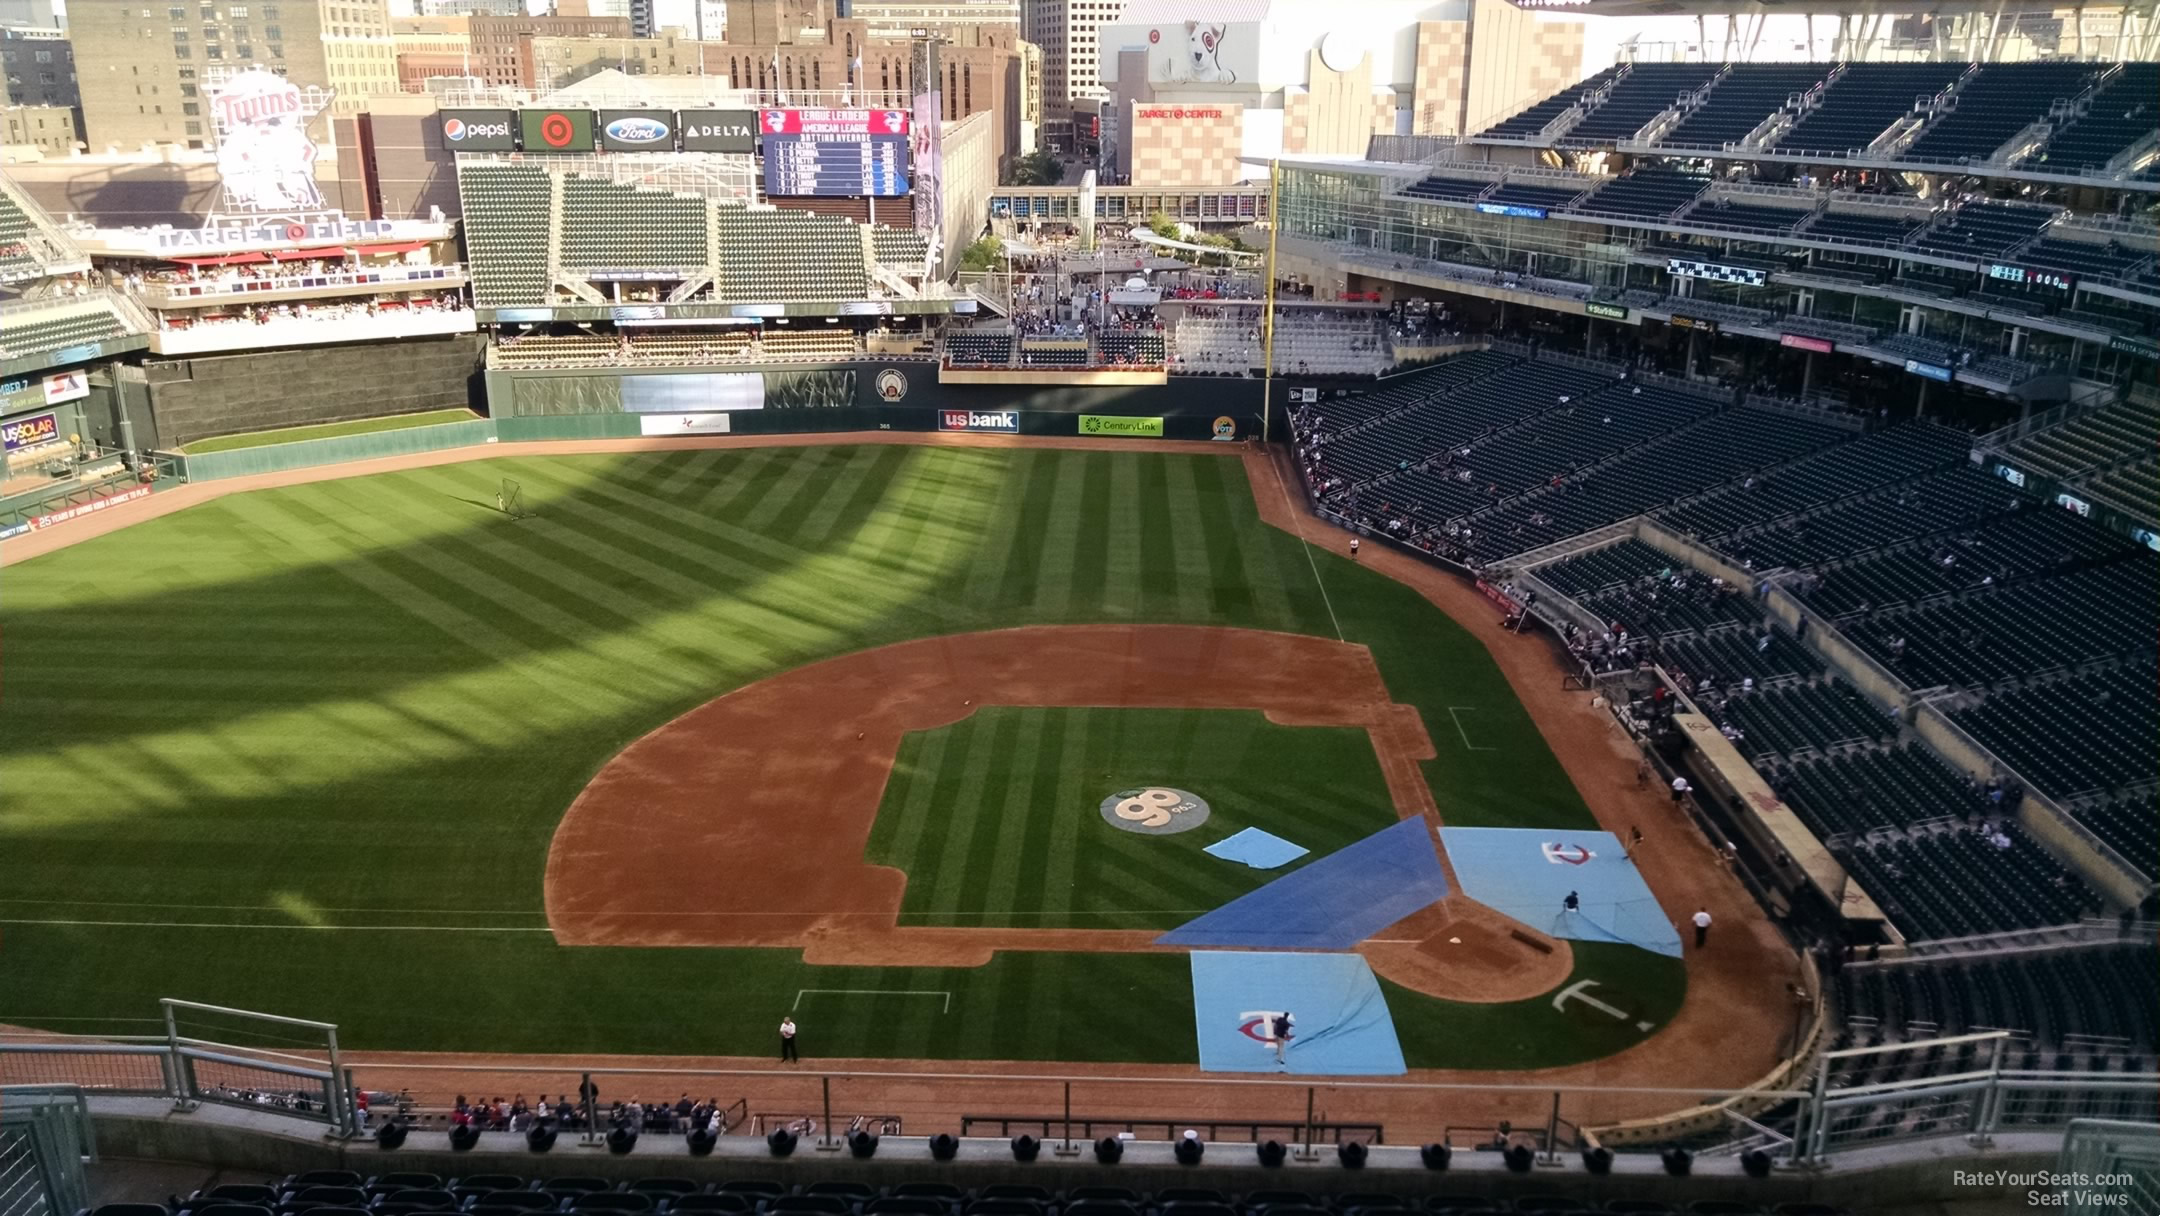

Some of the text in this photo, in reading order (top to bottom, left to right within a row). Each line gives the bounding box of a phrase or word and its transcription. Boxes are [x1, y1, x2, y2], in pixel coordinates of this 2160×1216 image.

[216, 91, 299, 127] Twins
[799, 110, 869, 120] LEAGUE LEADERS
[1138, 109, 1222, 118] TARGET CENTER
[467, 122, 510, 138] pepsi
[618, 122, 656, 139] Ford
[702, 125, 750, 137] DELTA
[801, 123, 869, 133] AMERICAN LEAGUE
[800, 134, 834, 142] BATTING
[158, 221, 394, 248] TARGET FIELD
[1104, 421, 1156, 431] CenturyLink
[39, 516, 51, 529] 25
[51, 511, 68, 524] YEARS
[69, 508, 77, 518] OF
[76, 502, 93, 517] GIVING
[110, 493, 129, 507] CHANCE
